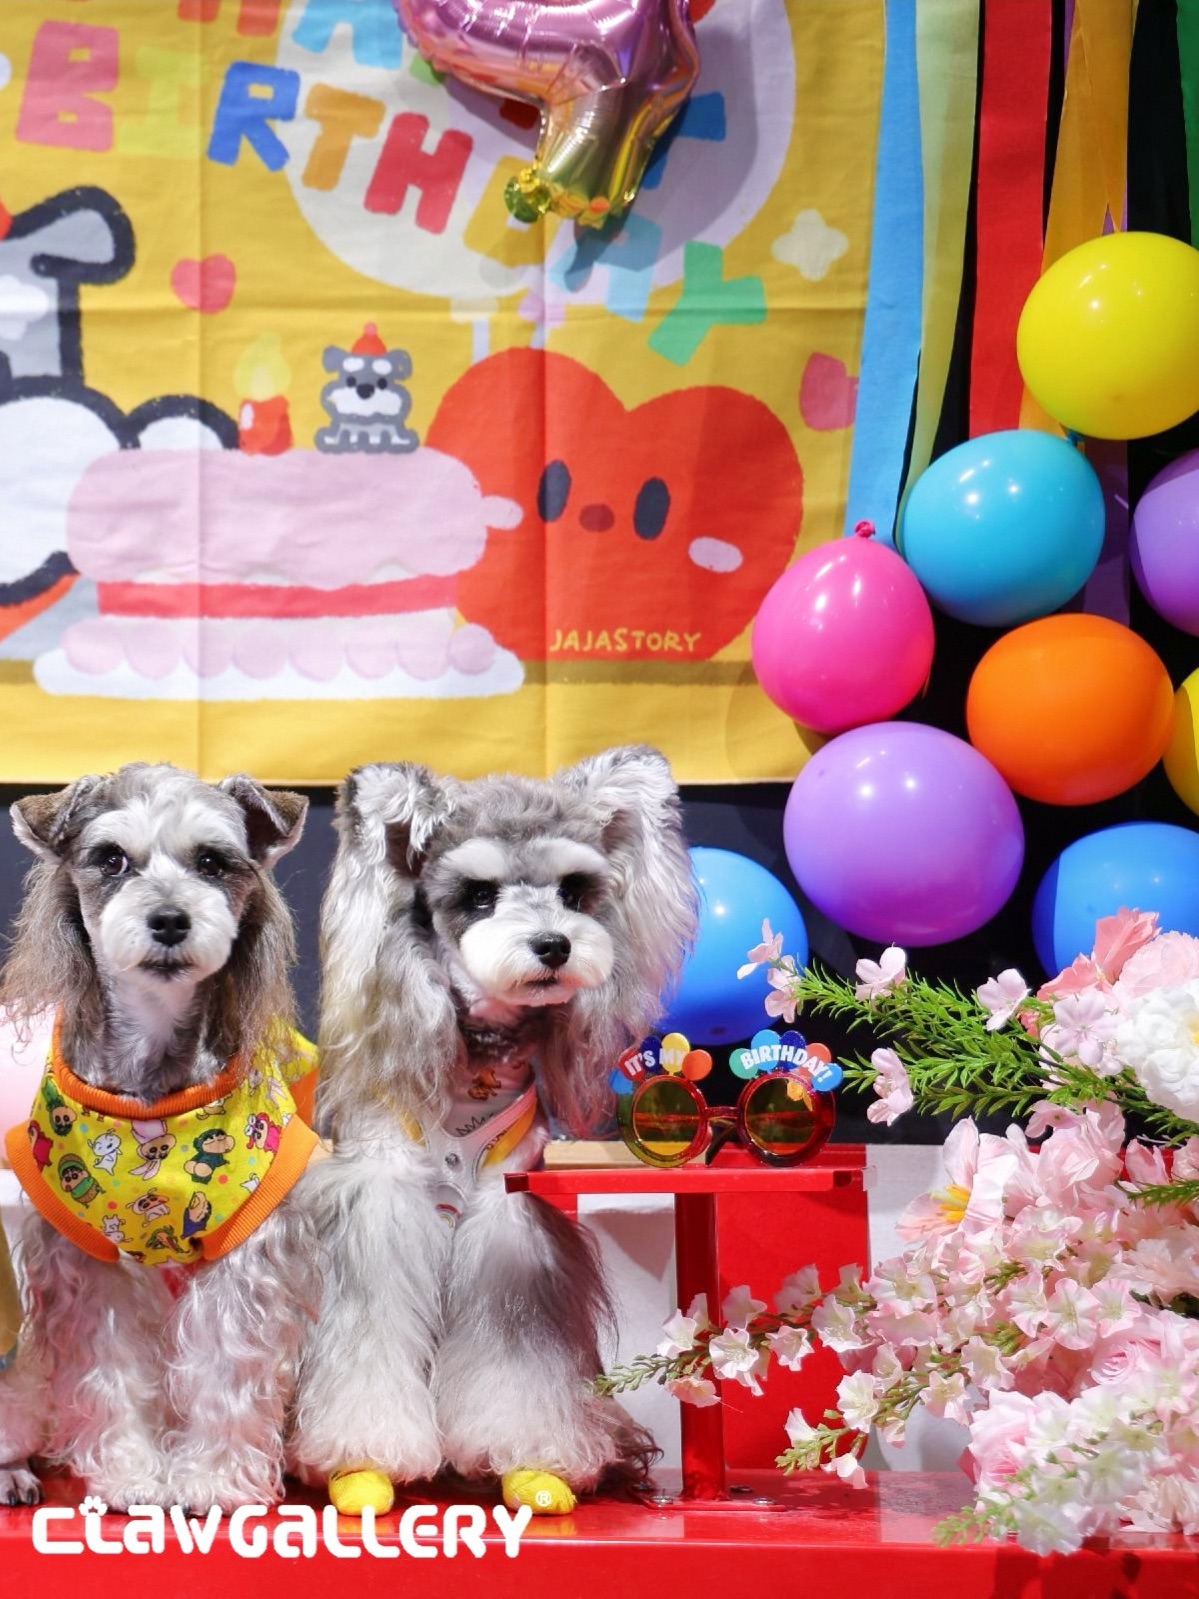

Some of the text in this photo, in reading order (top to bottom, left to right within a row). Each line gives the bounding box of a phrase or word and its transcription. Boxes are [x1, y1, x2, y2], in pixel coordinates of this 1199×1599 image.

[549, 626, 702, 652] JAJASTORY
[624, 1050, 657, 1077] IT'S
[739, 1043, 834, 1083] BIRTHDAY!
